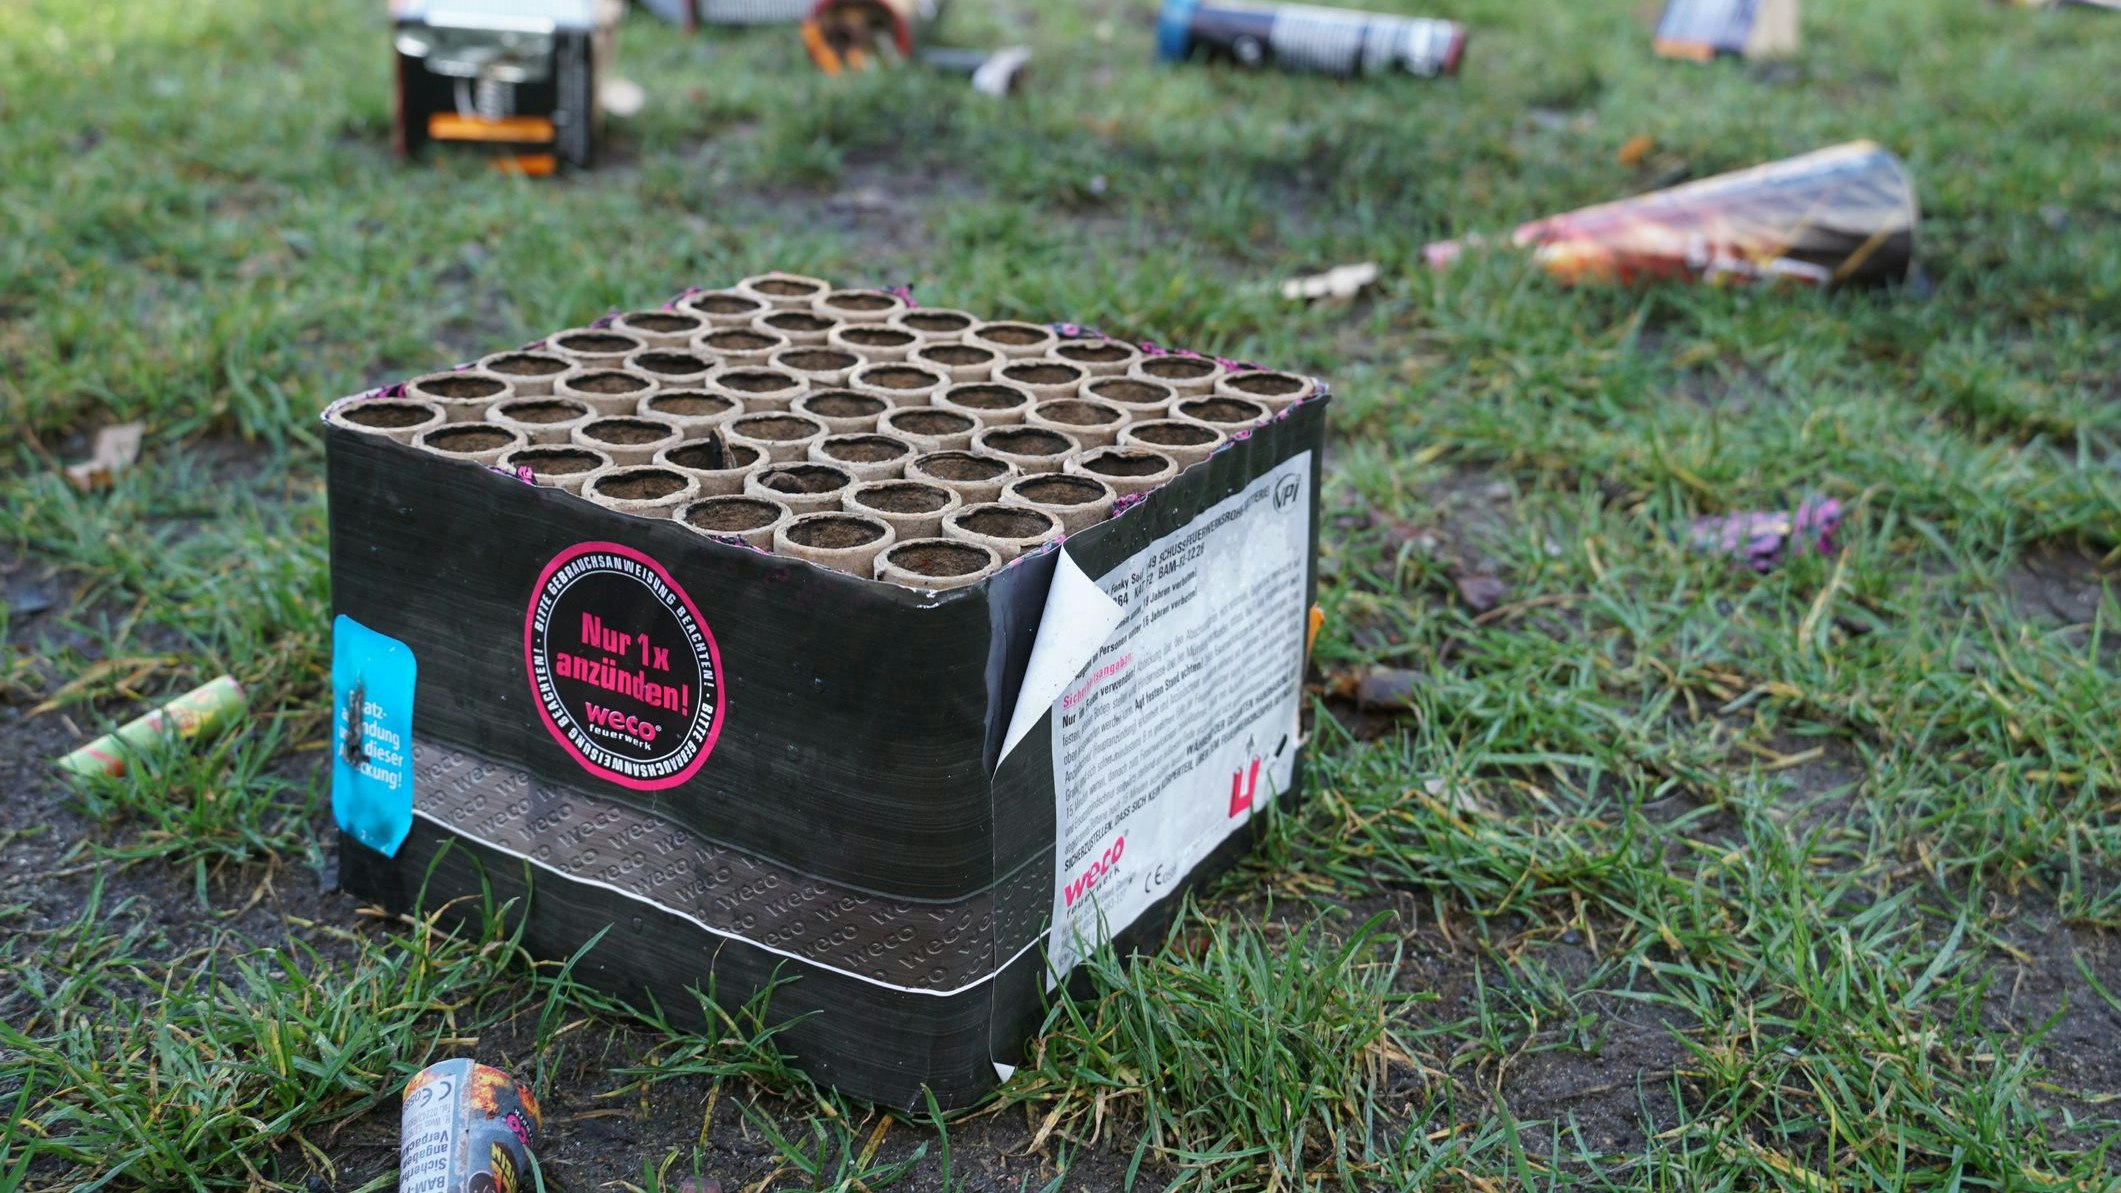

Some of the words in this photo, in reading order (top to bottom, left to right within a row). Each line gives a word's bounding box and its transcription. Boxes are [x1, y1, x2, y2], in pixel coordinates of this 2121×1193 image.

[534, 594, 552, 632] BITTE
[547, 555, 677, 605] GEBRAUCHSANWEISUNG
[676, 605, 715, 688] BEACHTEN!
[581, 611, 632, 656] Nur
[637, 633, 670, 671] 1x
[1099, 635, 1127, 658] Personen
[532, 648, 570, 728] BEACHTEN!
[555, 652, 689, 717] anzünden!
[585, 701, 656, 741] weco
[589, 723, 652, 751] feuerwerk
[693, 702, 714, 743] BITTE
[1062, 713, 1076, 729] Nur
[365, 739, 403, 768] dieser
[568, 727, 697, 777] GEBRAUCHSANWEISUNG
[1064, 836, 1125, 907] weco
